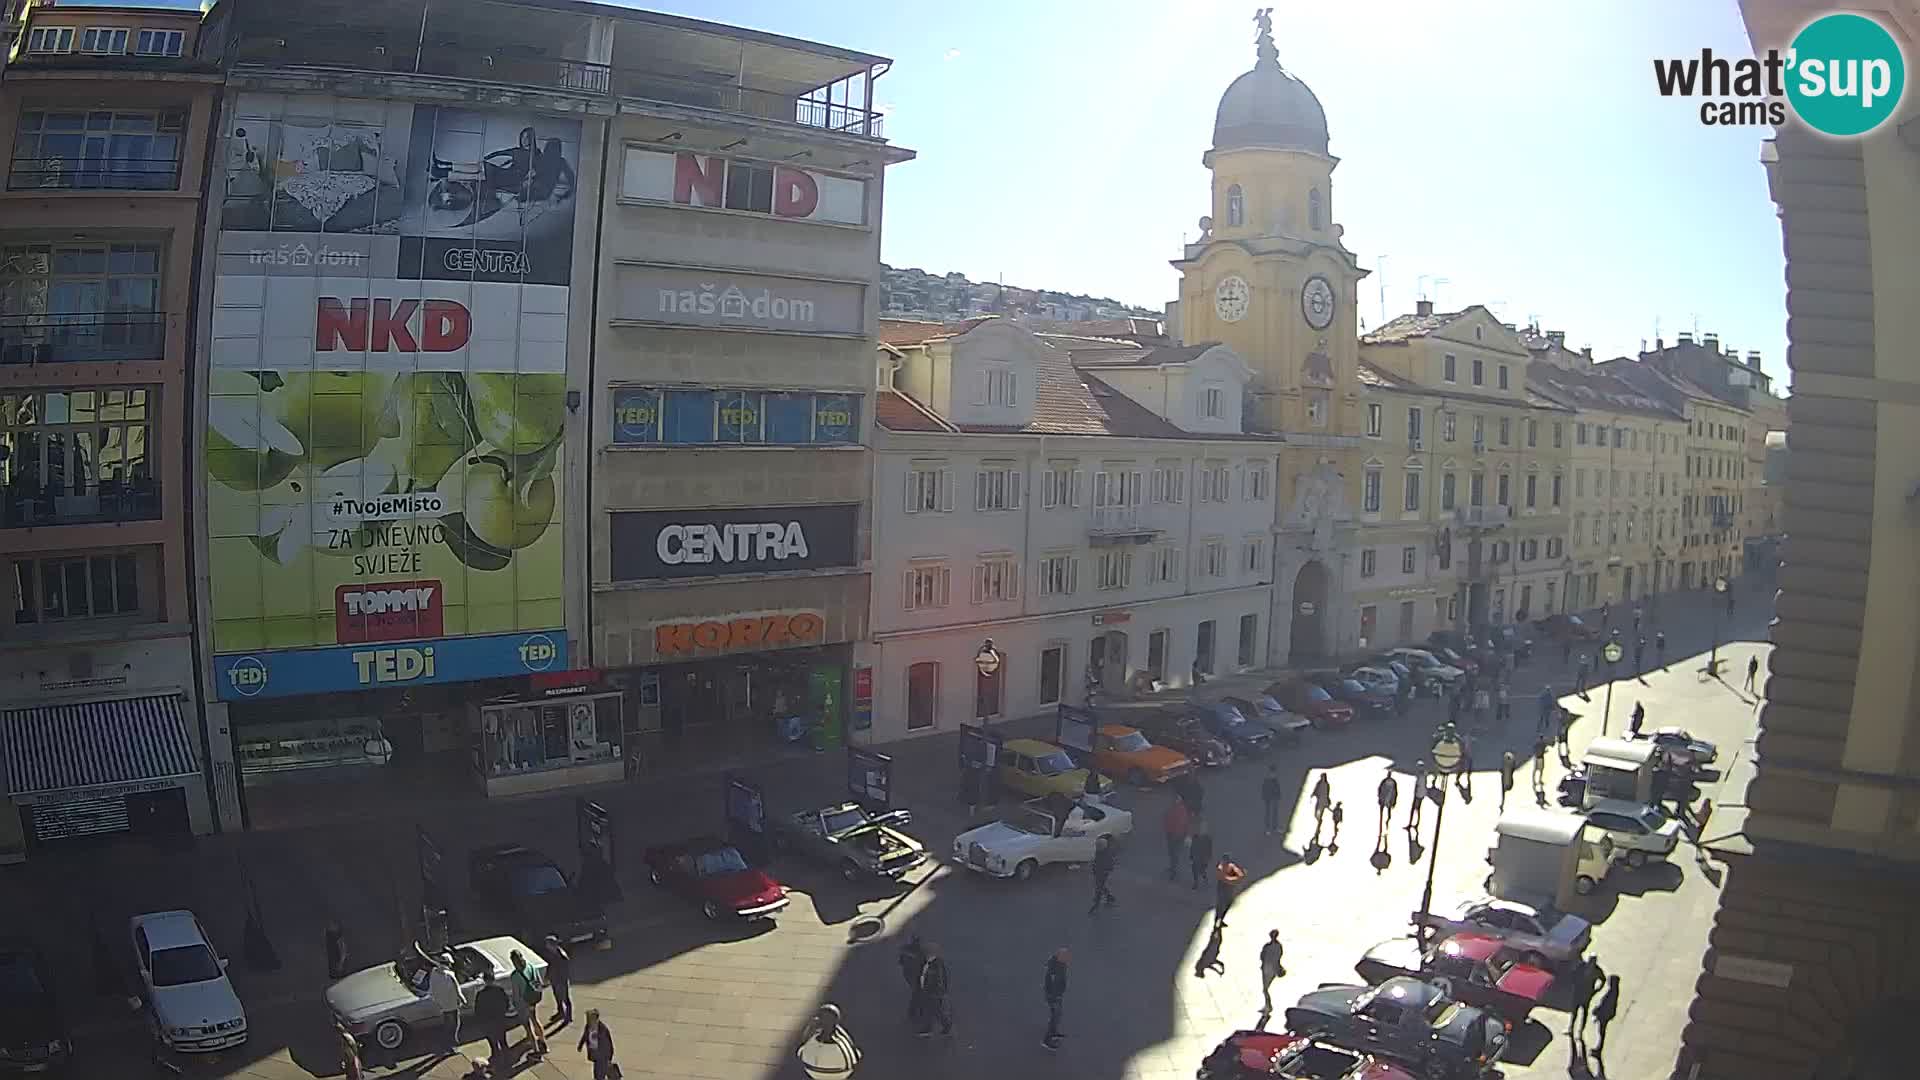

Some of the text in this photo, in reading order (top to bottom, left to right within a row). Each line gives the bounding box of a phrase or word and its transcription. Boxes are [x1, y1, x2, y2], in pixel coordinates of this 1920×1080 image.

[248, 243, 361, 267] naš dom
[443, 248, 532, 274] CENTRA
[657, 282, 816, 323] naš dom
[315, 296, 473, 353] NKD
[332, 495, 443, 517] #TvojeMisto
[328, 520, 446, 551] ZA DNEVNO
[655, 521, 809, 565] CENTRA
[353, 548, 423, 577] SVJEŽE
[342, 586, 435, 616] TOMMY
[656, 612, 824, 654] KORZO
[351, 646, 436, 685] TEDi
[517, 644, 557, 663] TEDi
[227, 666, 268, 685] TEDi
